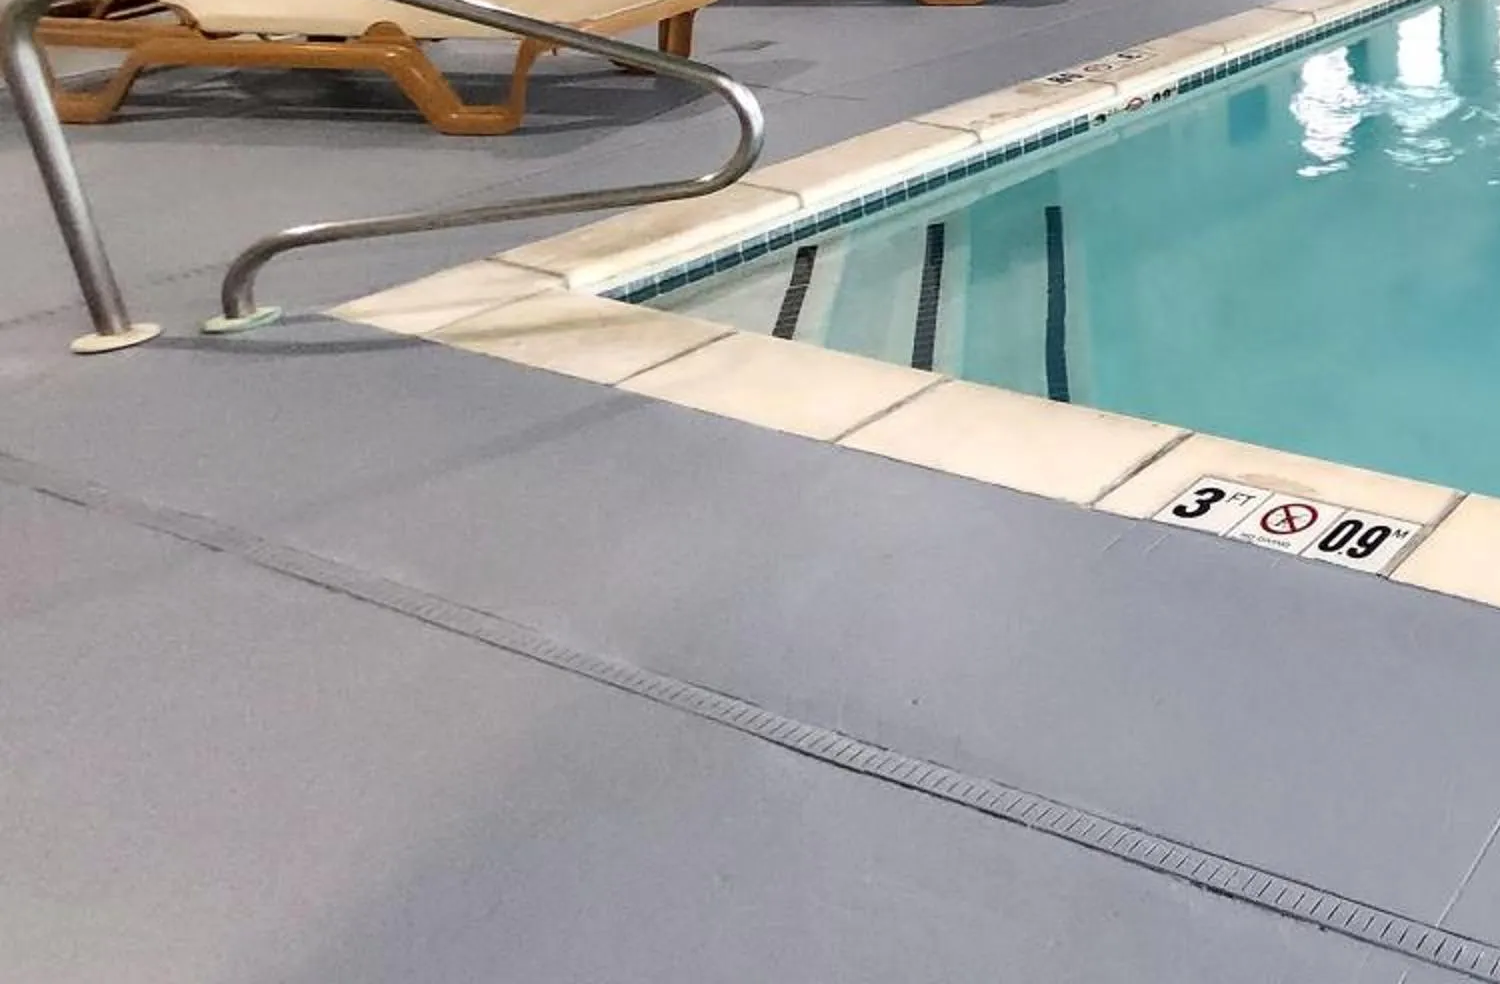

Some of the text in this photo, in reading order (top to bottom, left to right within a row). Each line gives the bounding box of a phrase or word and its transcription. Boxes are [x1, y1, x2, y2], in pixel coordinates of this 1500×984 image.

[1172, 487, 1256, 519] 3 FT
[1391, 528, 1410, 540] M
